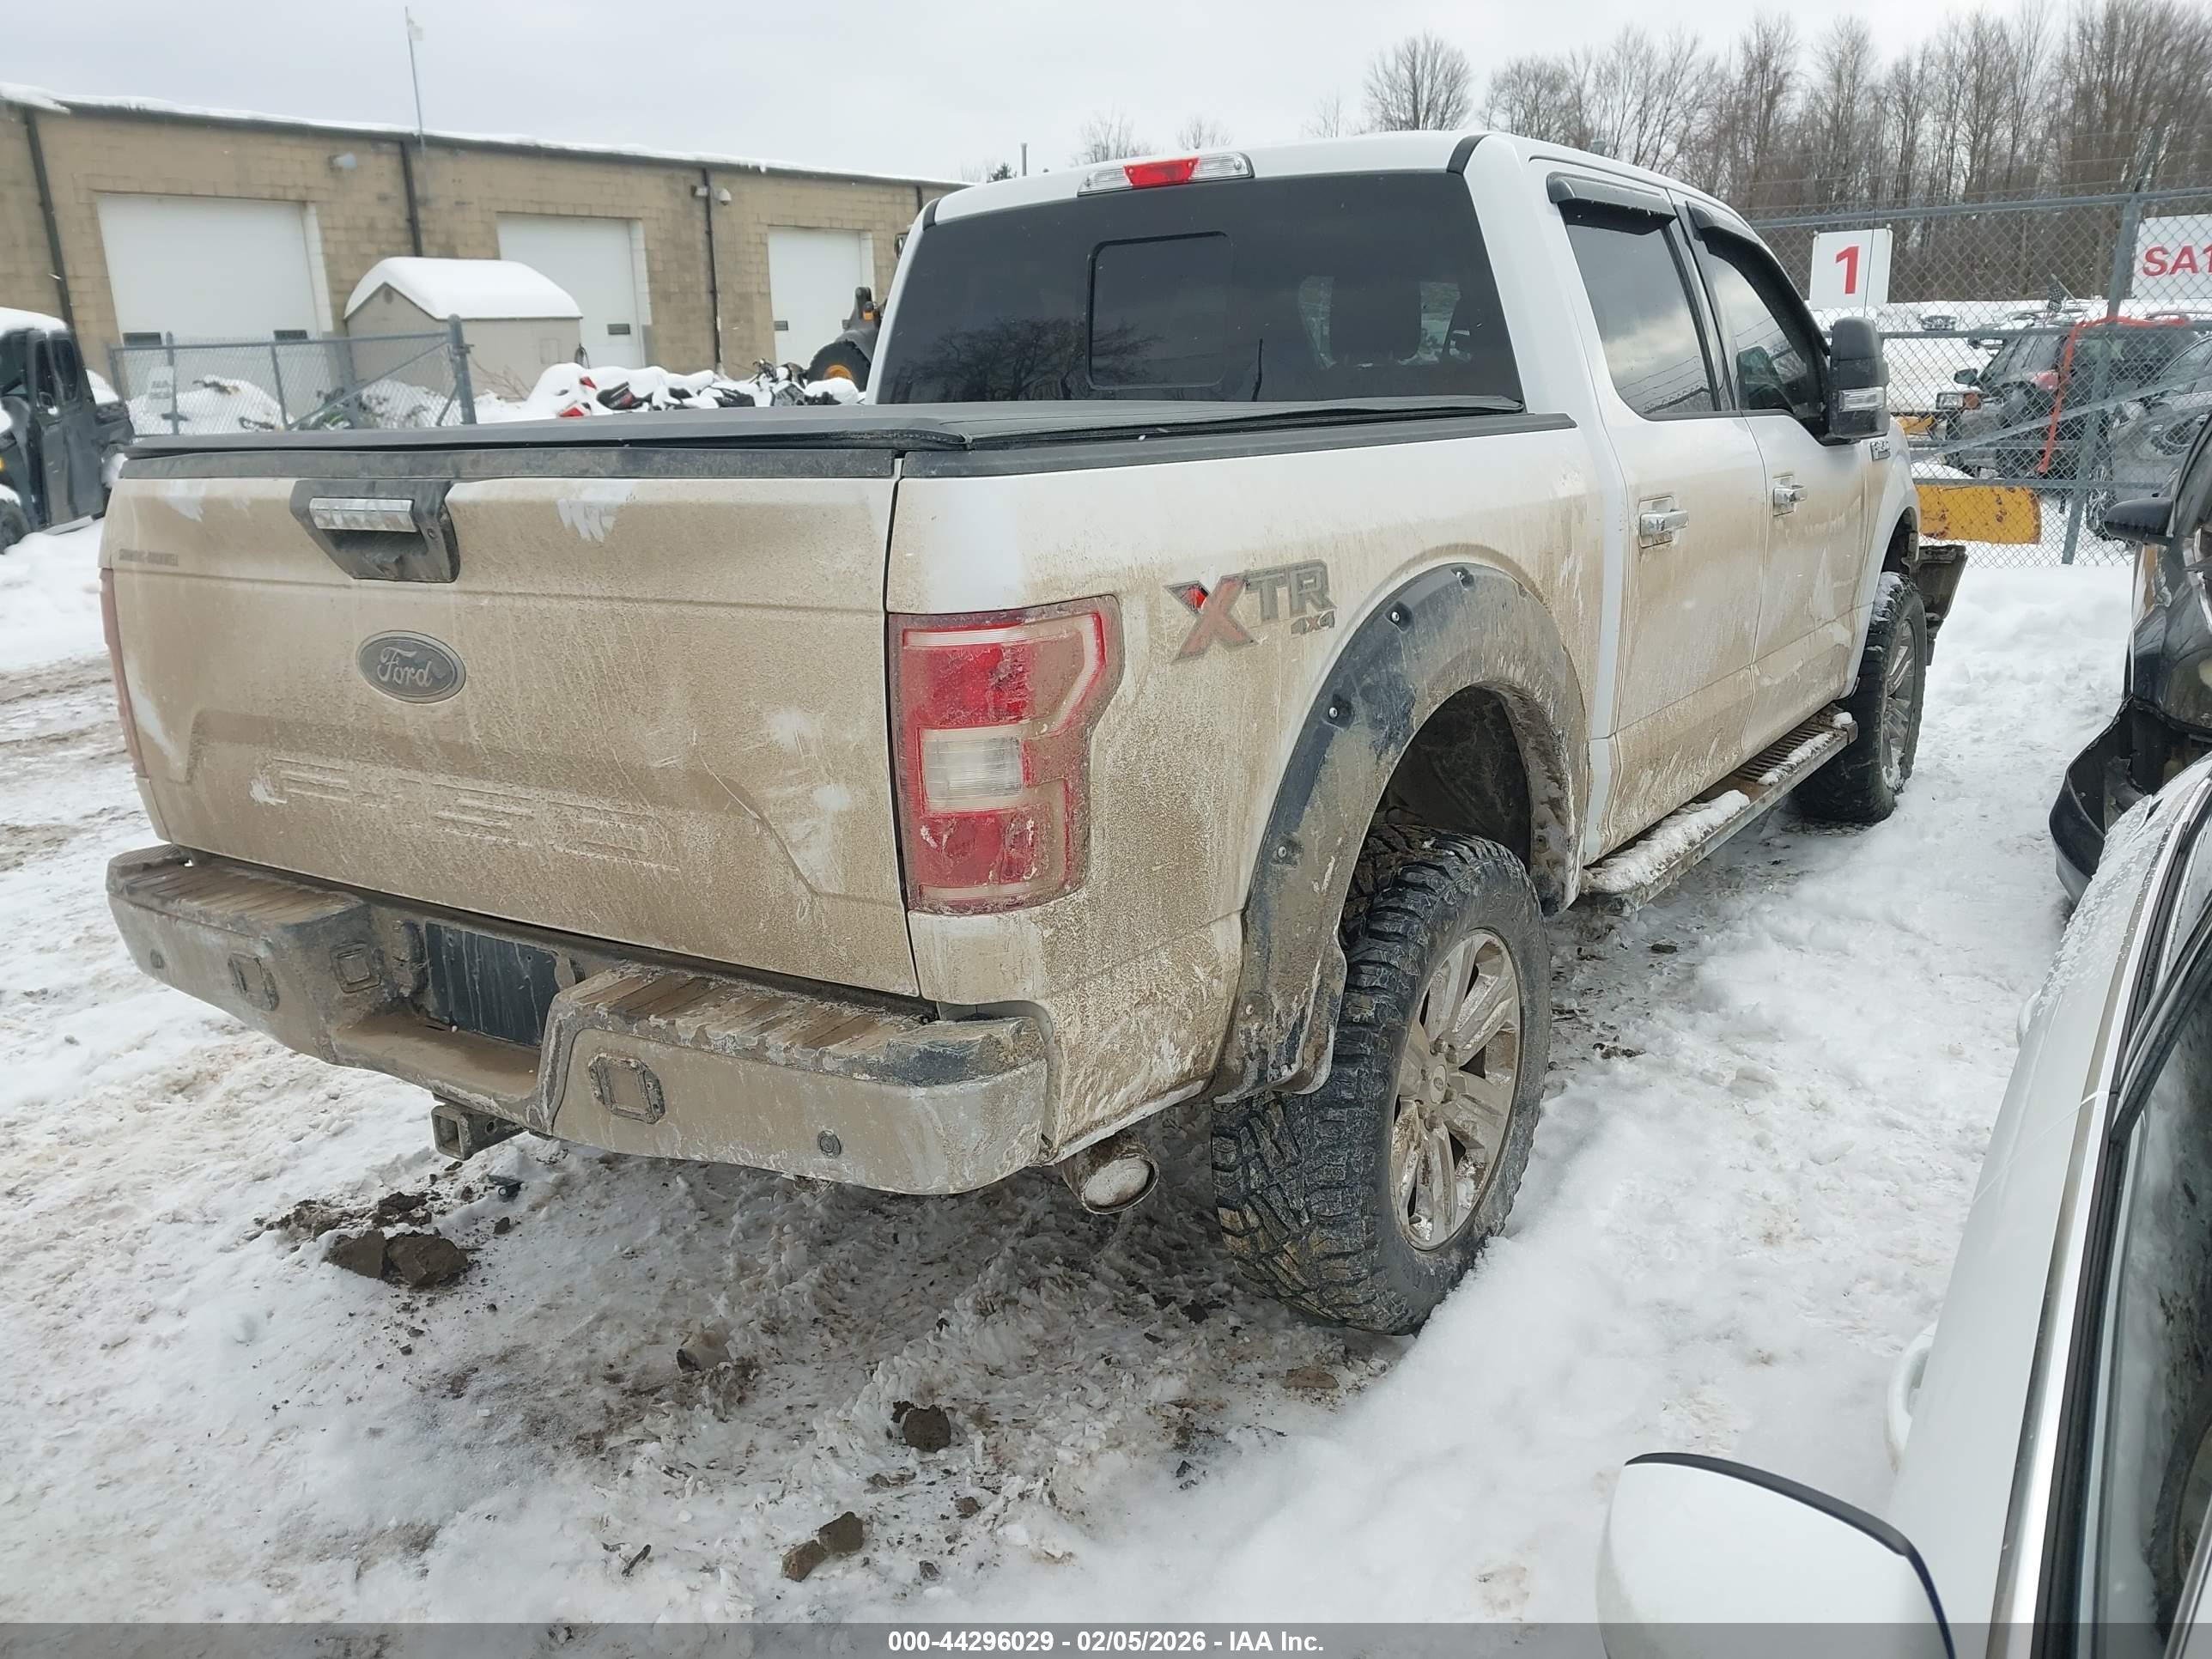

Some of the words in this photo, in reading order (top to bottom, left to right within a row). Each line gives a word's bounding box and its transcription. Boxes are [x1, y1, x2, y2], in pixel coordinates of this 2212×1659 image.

[1835, 246, 1860, 295] 1
[1165, 559, 1338, 665] XTR
[377, 646, 434, 688] Ford
